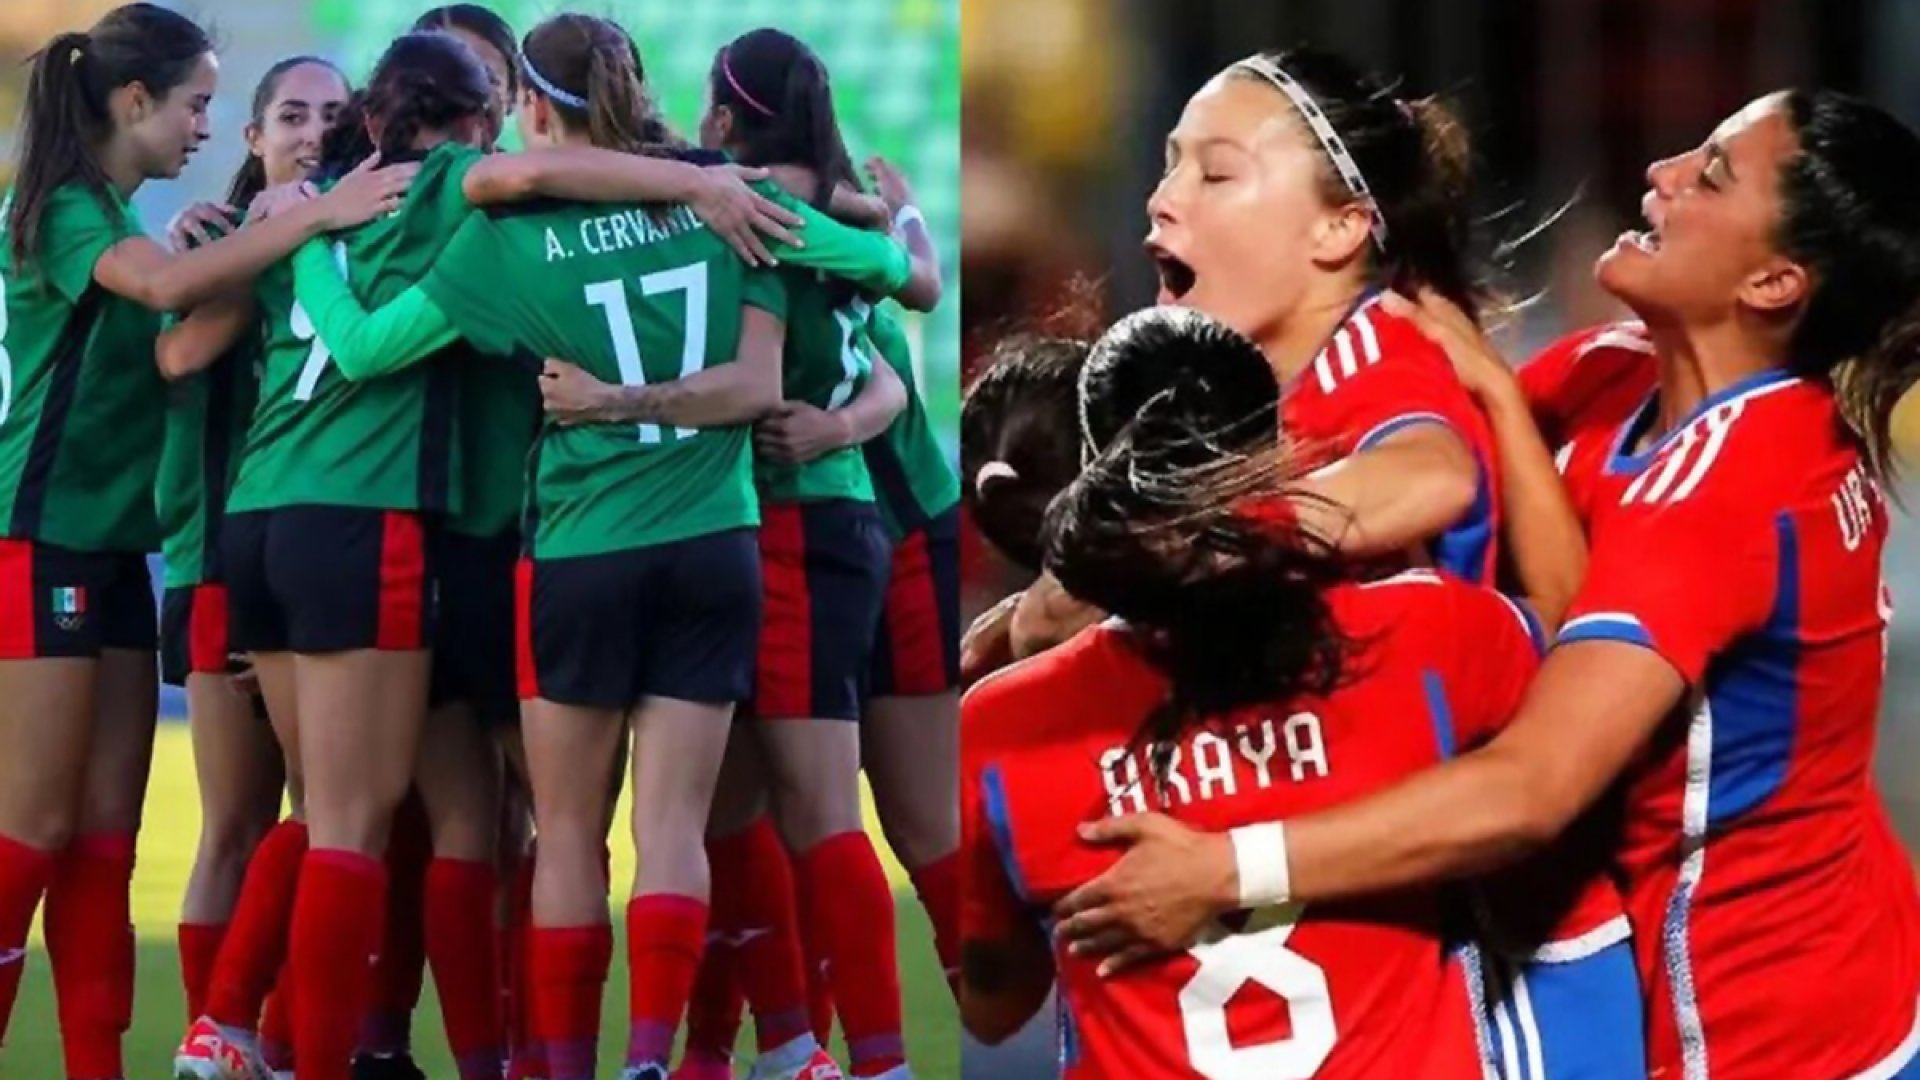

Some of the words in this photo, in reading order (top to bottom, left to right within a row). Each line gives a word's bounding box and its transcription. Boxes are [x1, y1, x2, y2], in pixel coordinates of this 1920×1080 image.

[545, 226, 575, 262] A.
[584, 261, 708, 443] 17
[1178, 905, 1339, 1080] 8
